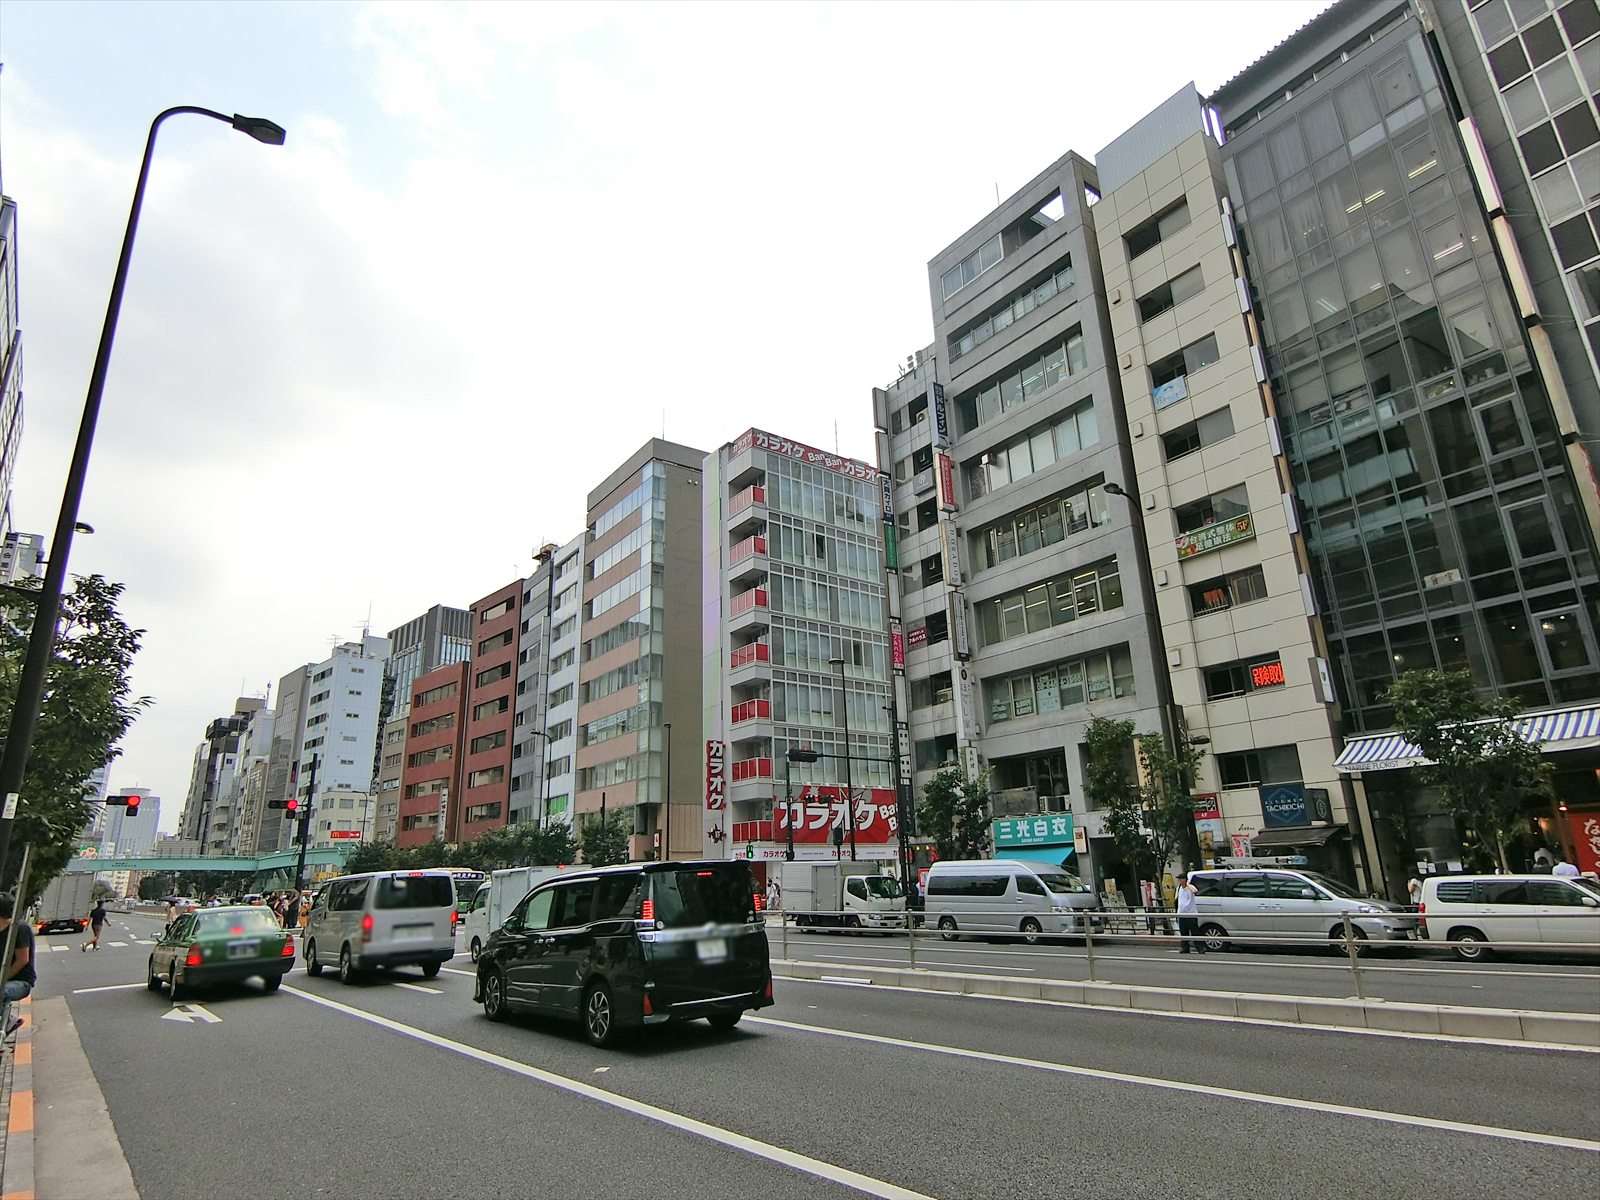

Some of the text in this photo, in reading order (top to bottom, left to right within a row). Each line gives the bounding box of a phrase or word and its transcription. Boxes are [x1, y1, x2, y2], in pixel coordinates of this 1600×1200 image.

[733, 433, 752, 452] カラオケ
[756, 433, 805, 458] カラオケ
[808, 452, 825, 462] Ban
[825, 457, 843, 468] Ban
[844, 461, 889, 483] カラオ
[1236, 519, 1249, 532] 5F
[709, 740, 724, 809] カラオケ
[1345, 760, 1399, 772] NARUSE FLORIST
[779, 800, 878, 831] カラオケ
[1265, 803, 1305, 812] TACHIKICHI
[1000, 817, 1067, 839] 三光白衣
